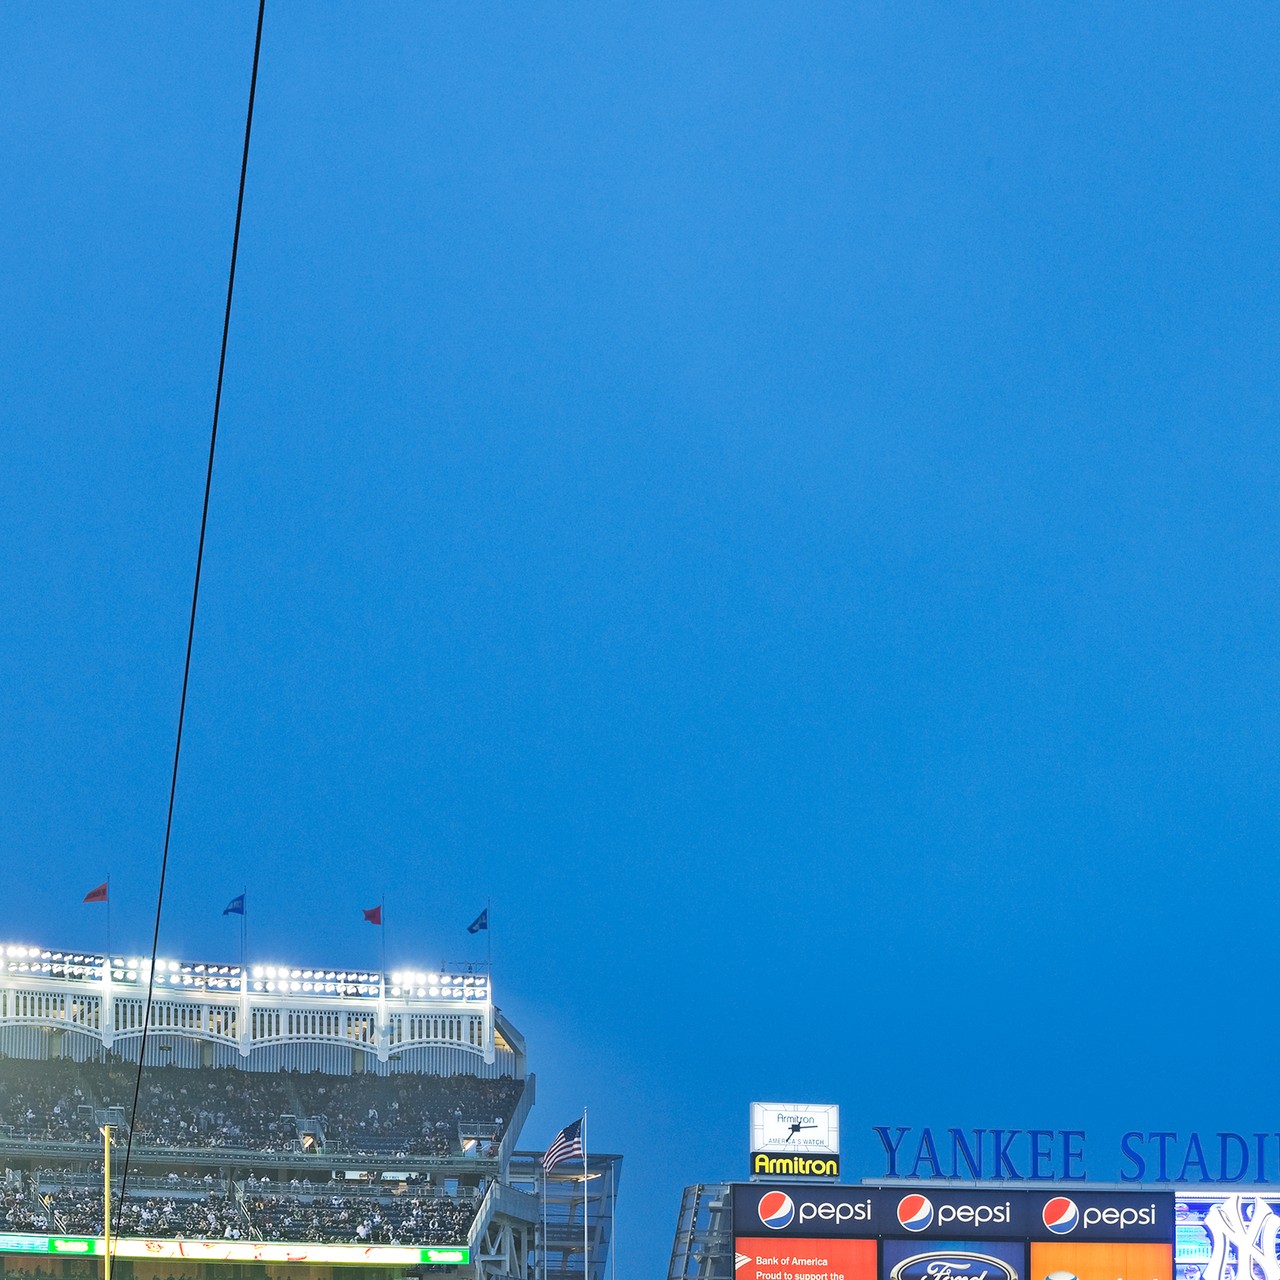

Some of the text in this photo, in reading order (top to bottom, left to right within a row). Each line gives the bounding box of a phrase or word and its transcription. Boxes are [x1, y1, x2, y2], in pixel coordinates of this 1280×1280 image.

[777, 1113, 814, 1123] Armitron
[755, 1154, 837, 1175] Armitron
[872, 1126, 1087, 1180] YANKEE
[799, 1199, 871, 1224] pepsi
[938, 1202, 1010, 1227] pepsi
[1084, 1204, 1155, 1229] pepsi
[756, 1256, 828, 1266] Bank of America
[756, 1272, 781, 1280] Proud
[784, 1272, 792, 1280] to
[830, 1272, 844, 1280] the
